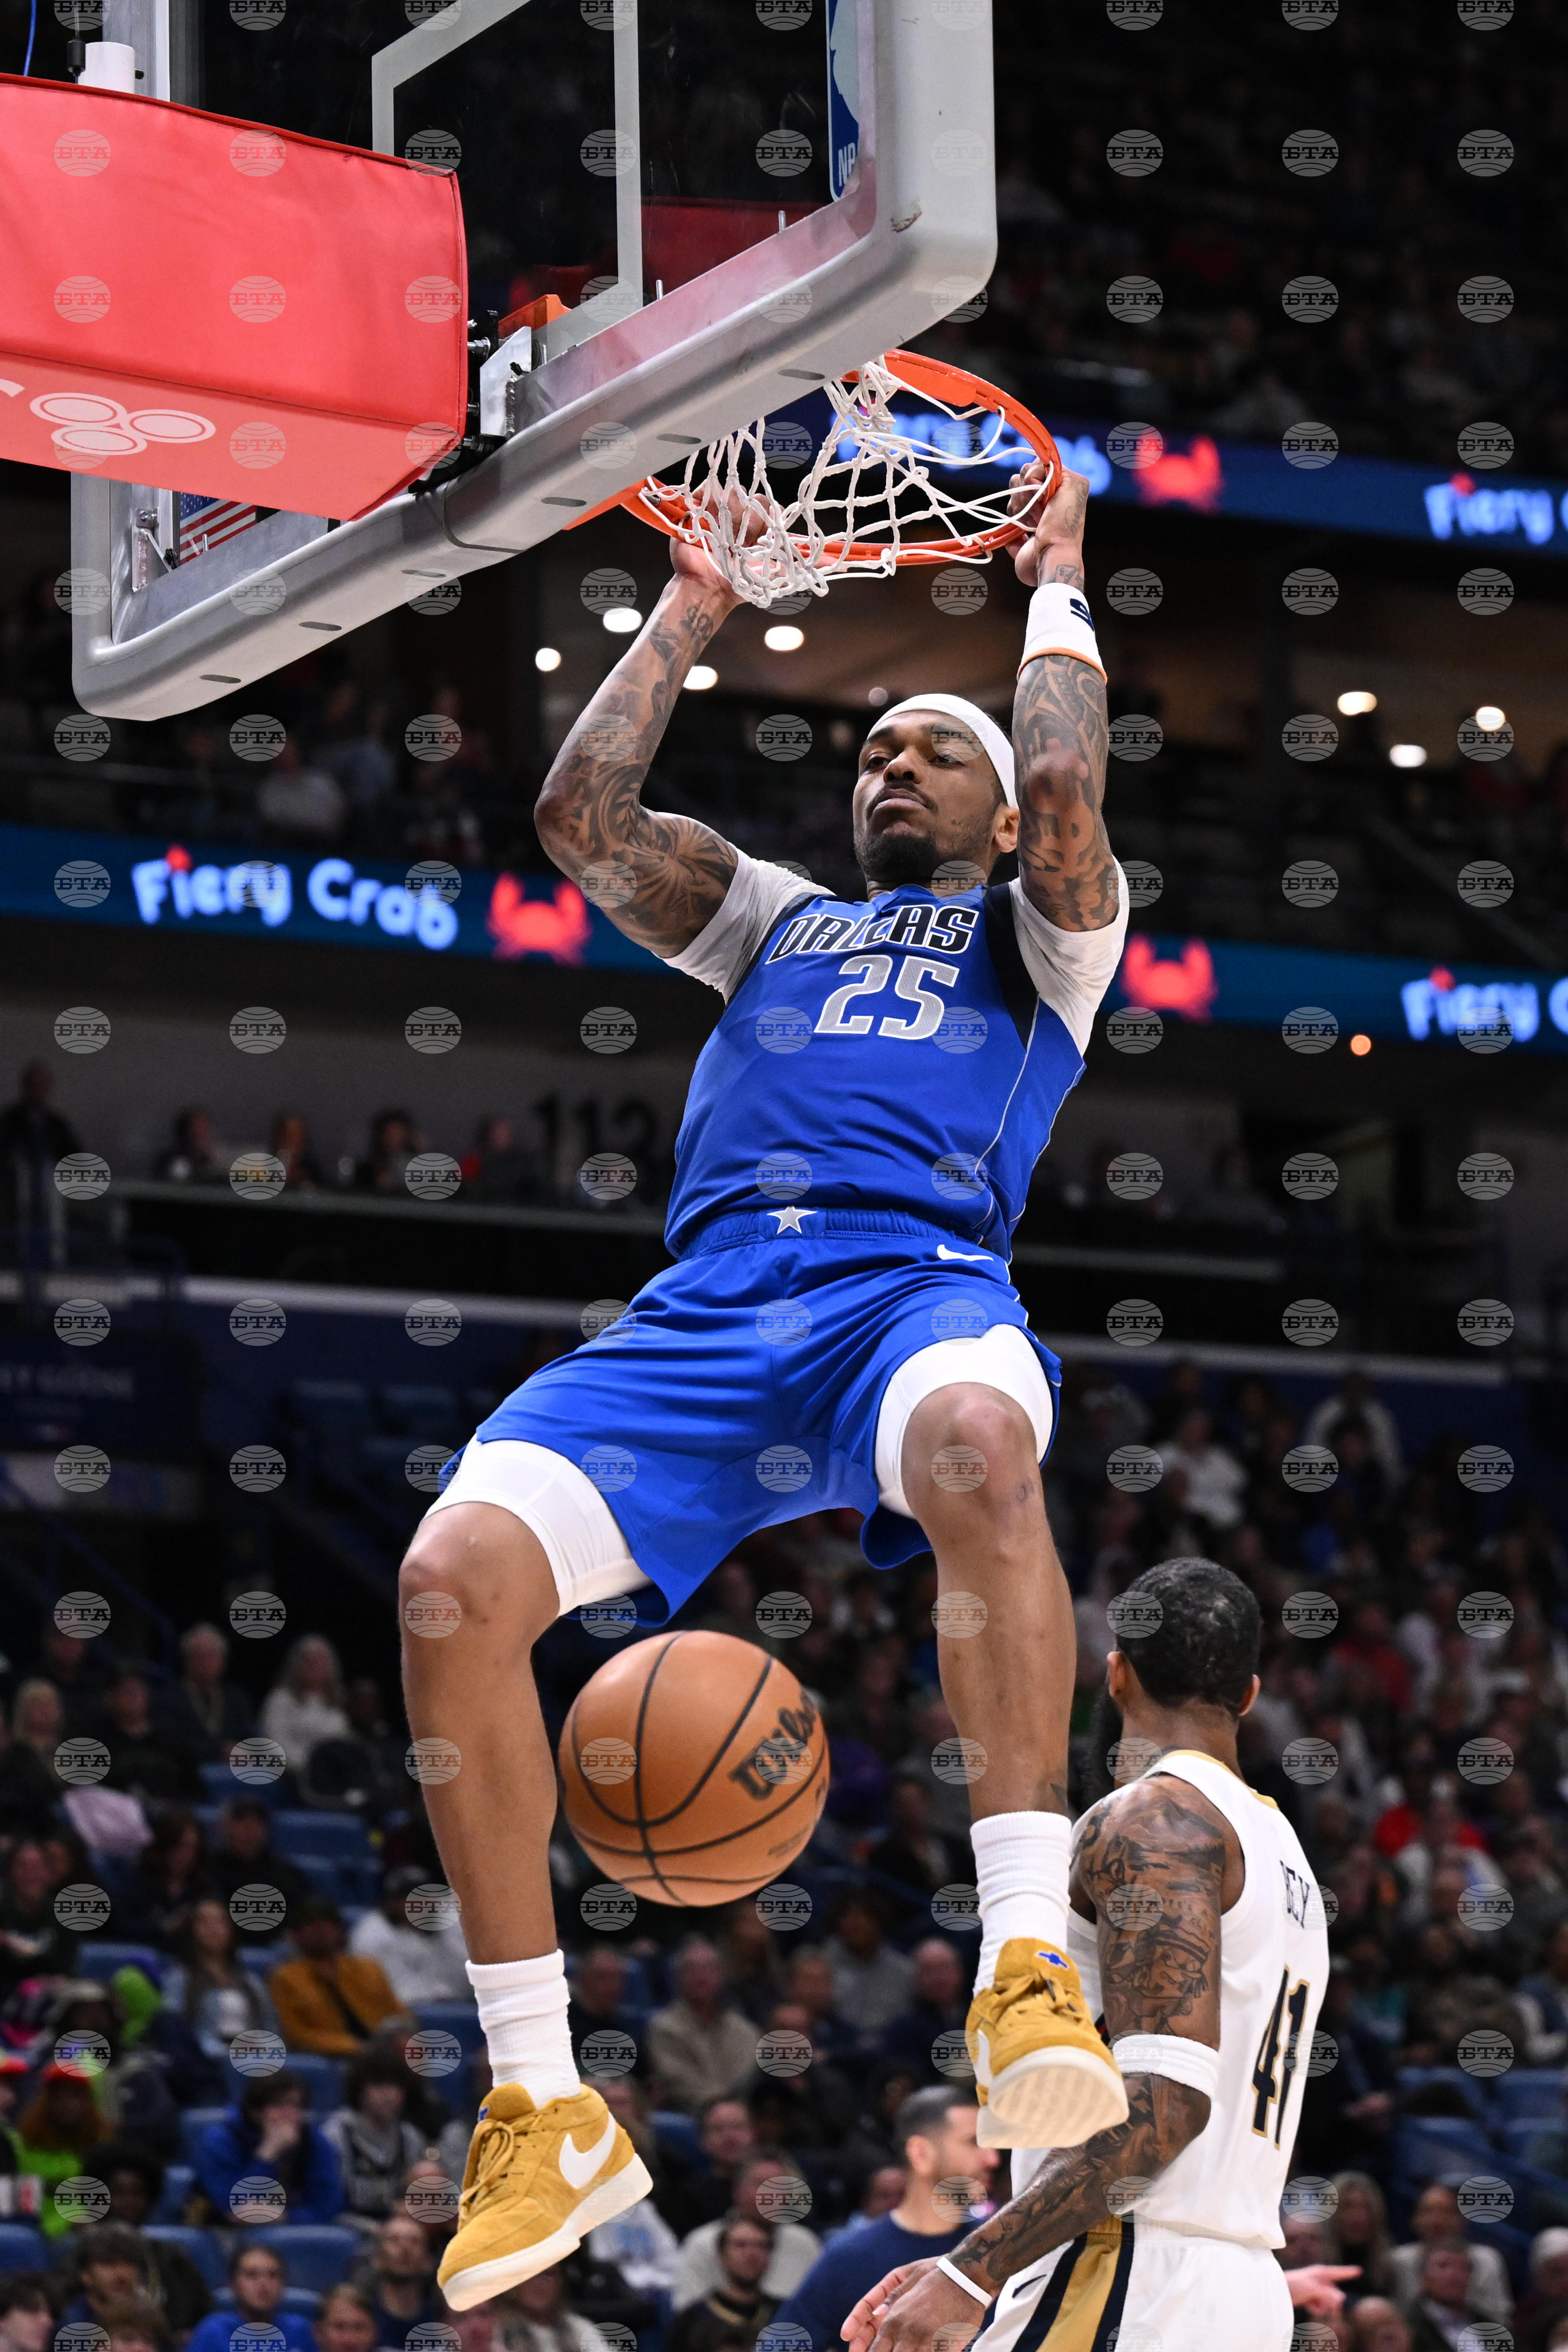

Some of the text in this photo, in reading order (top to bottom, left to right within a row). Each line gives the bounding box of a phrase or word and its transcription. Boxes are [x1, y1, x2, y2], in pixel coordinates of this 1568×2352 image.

[132, 845, 458, 950] Fiery Crab
[765, 904, 979, 965] DALLAS
[813, 955, 960, 1040] 25
[1251, 1964, 1310, 2151] 41
